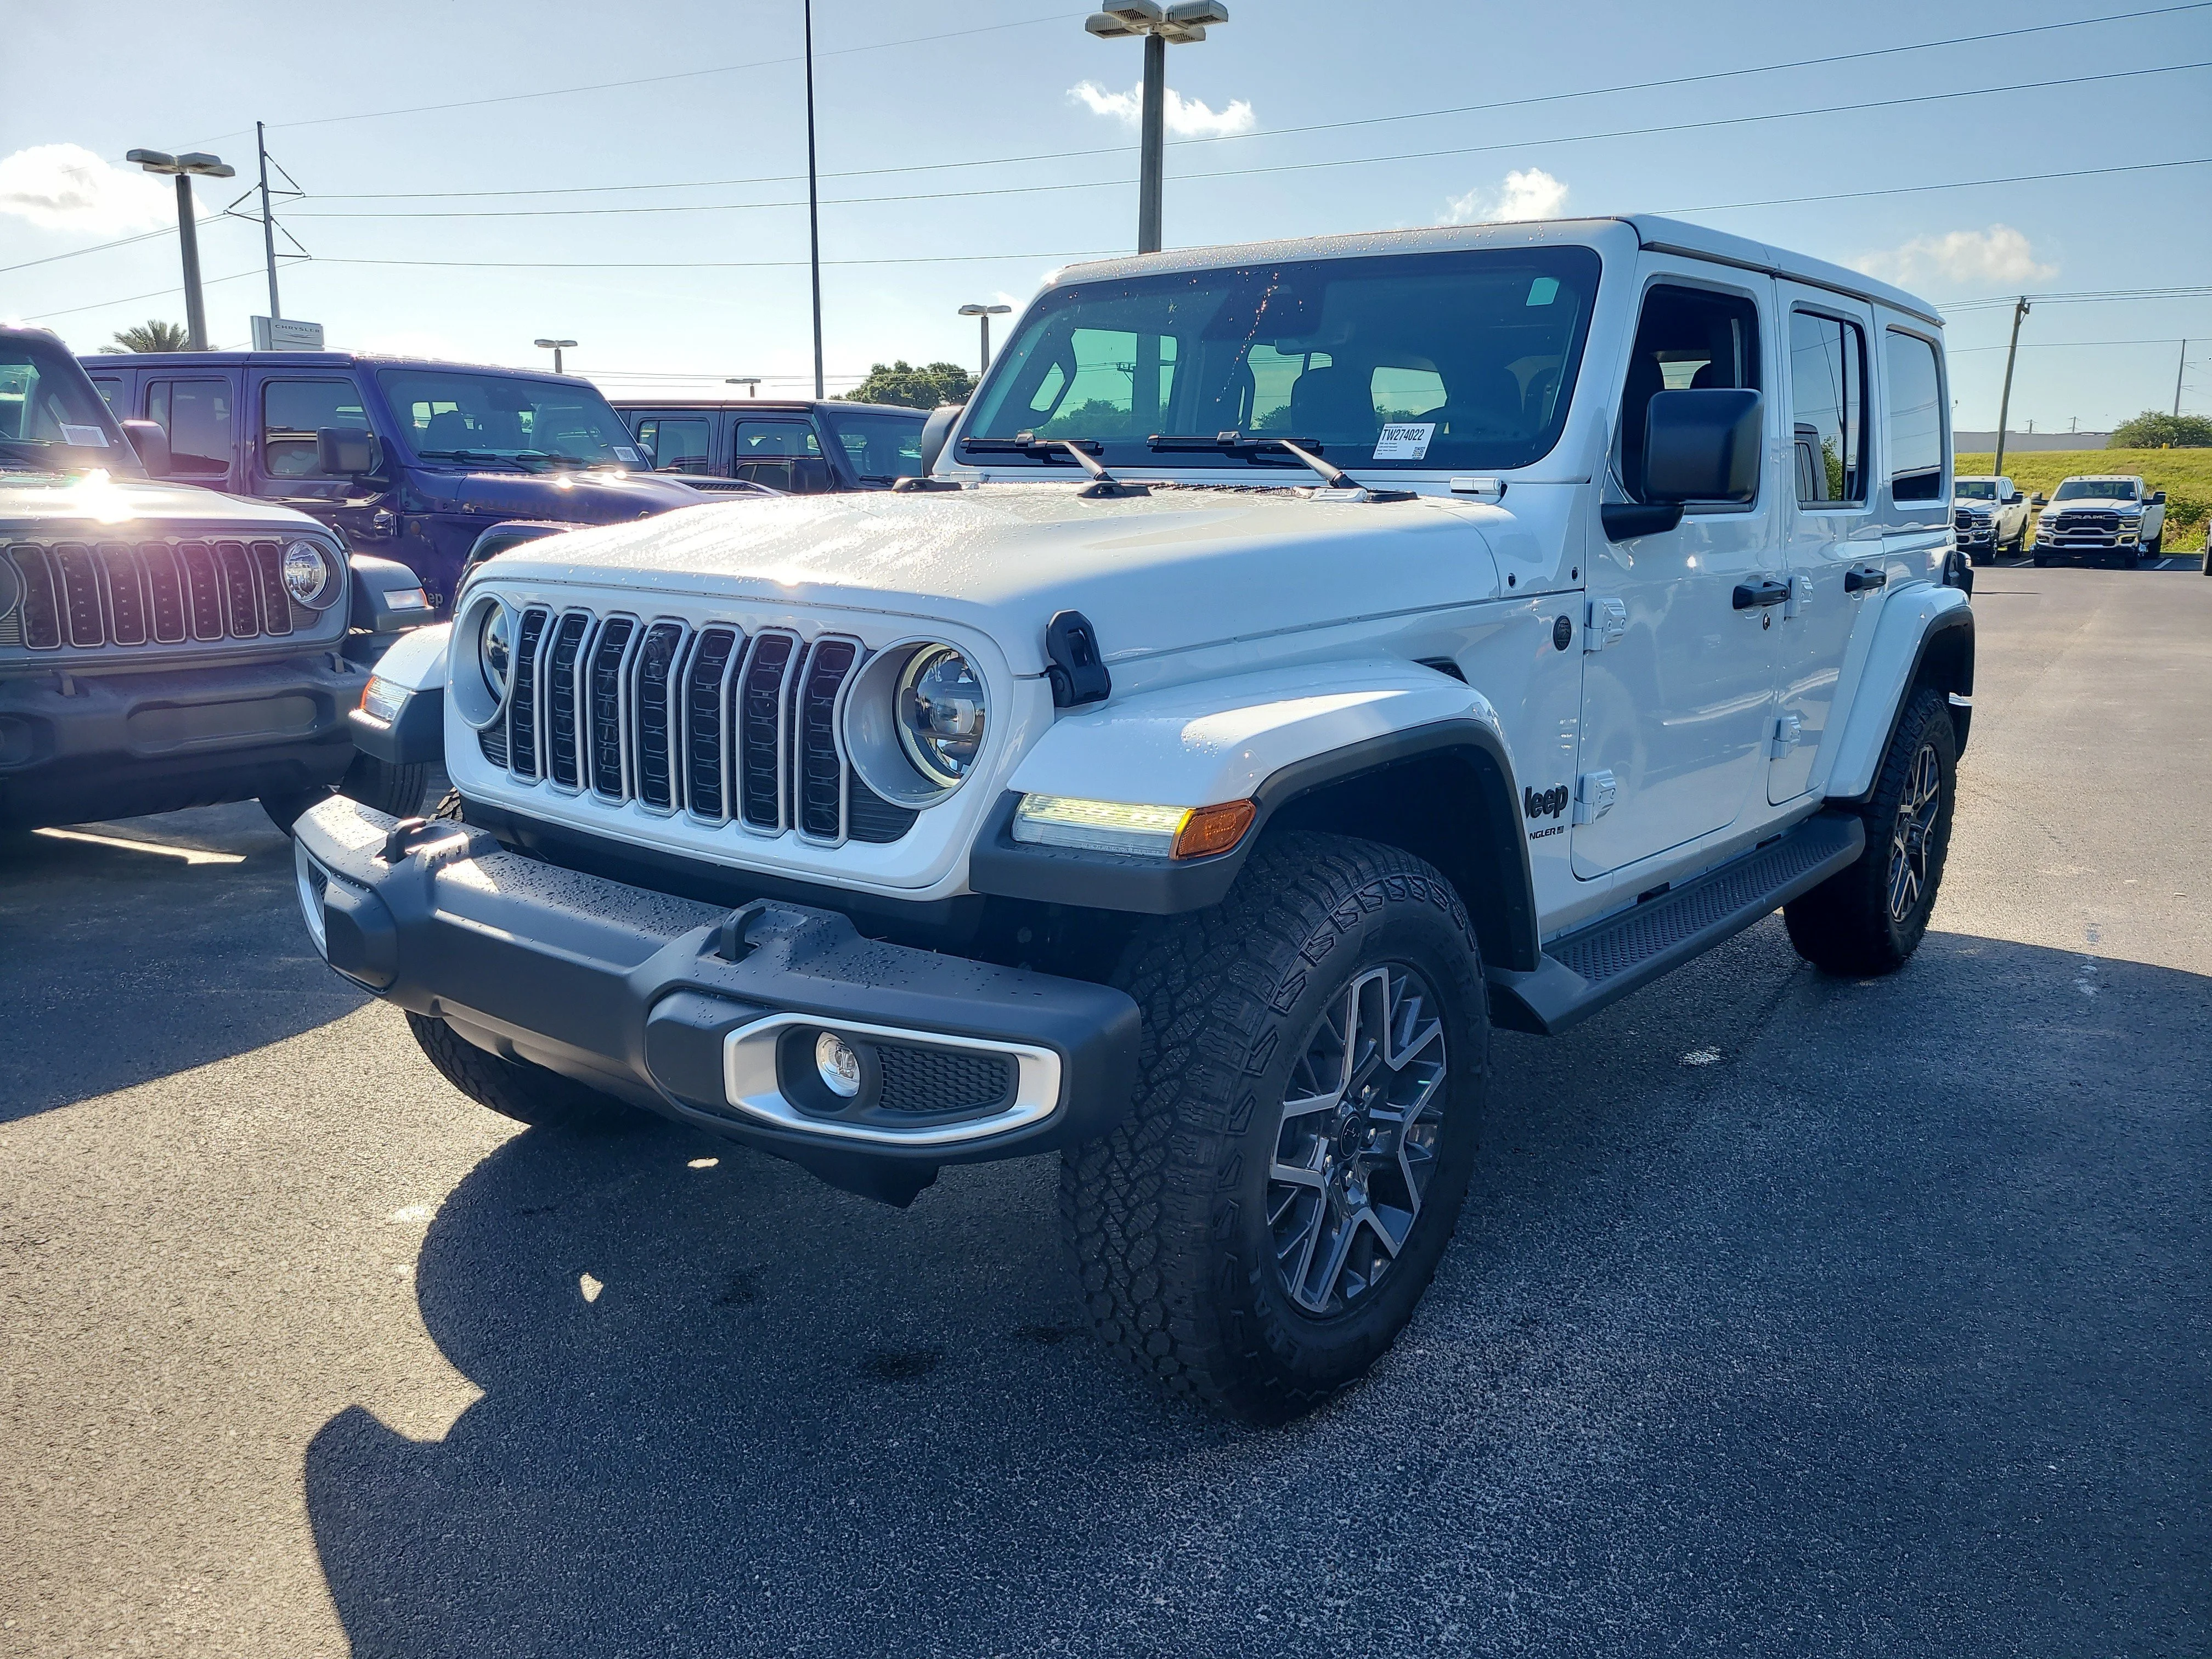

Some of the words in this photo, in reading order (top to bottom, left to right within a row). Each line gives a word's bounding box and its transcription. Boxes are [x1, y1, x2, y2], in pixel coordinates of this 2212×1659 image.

[275, 324, 320, 332] CHRYSLER
[1381, 429, 1425, 441] TW274022
[427, 593, 444, 607] ep
[1530, 827, 1556, 840] NGLER
